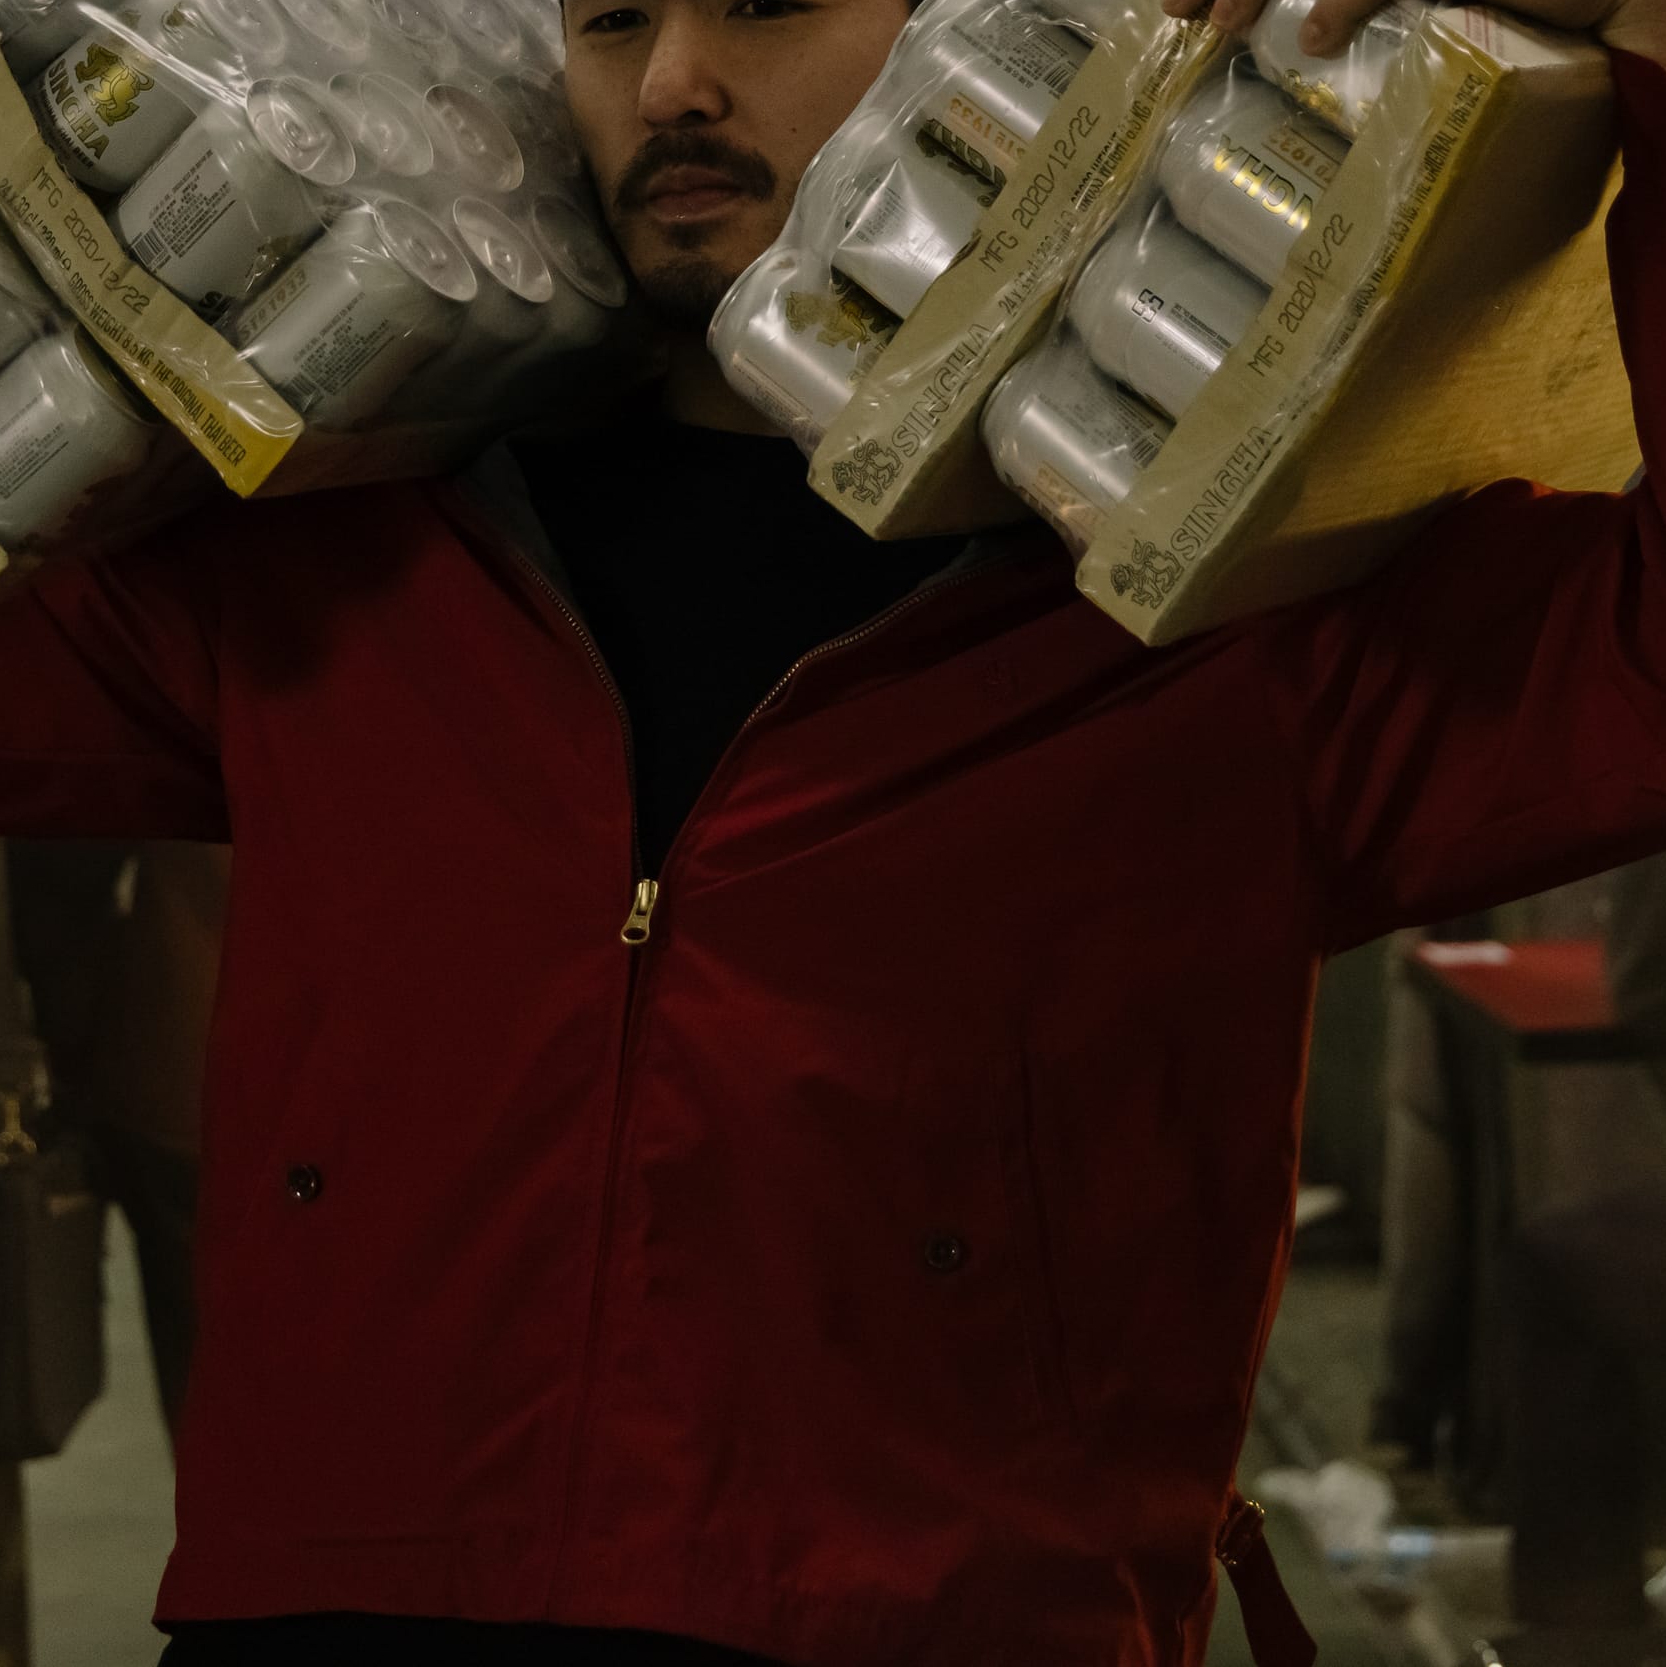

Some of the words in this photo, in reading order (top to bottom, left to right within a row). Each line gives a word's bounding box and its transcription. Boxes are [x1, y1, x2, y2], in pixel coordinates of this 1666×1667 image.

[48, 58, 110, 161] SINGHA
[1413, 128, 1459, 182] ORIGINAL
[33, 166, 63, 208] MFG
[64, 208, 151, 315] 2020/12/22
[979, 230, 1019, 273] MFG
[1012, 106, 1100, 230] 2020/12/22
[11, 196, 32, 217] 33
[86, 299, 128, 343] WEIGHT
[149, 359, 173, 383] THE
[163, 375, 209, 422] ORIGINAL
[197, 413, 228, 444] THAI
[215, 433, 248, 467] BEER
[1248, 335, 1284, 377] MFG
[1278, 214, 1353, 333] 2020/12/22
[892, 323, 991, 458] SINGHA
[1170, 426, 1272, 562] SINGHA
